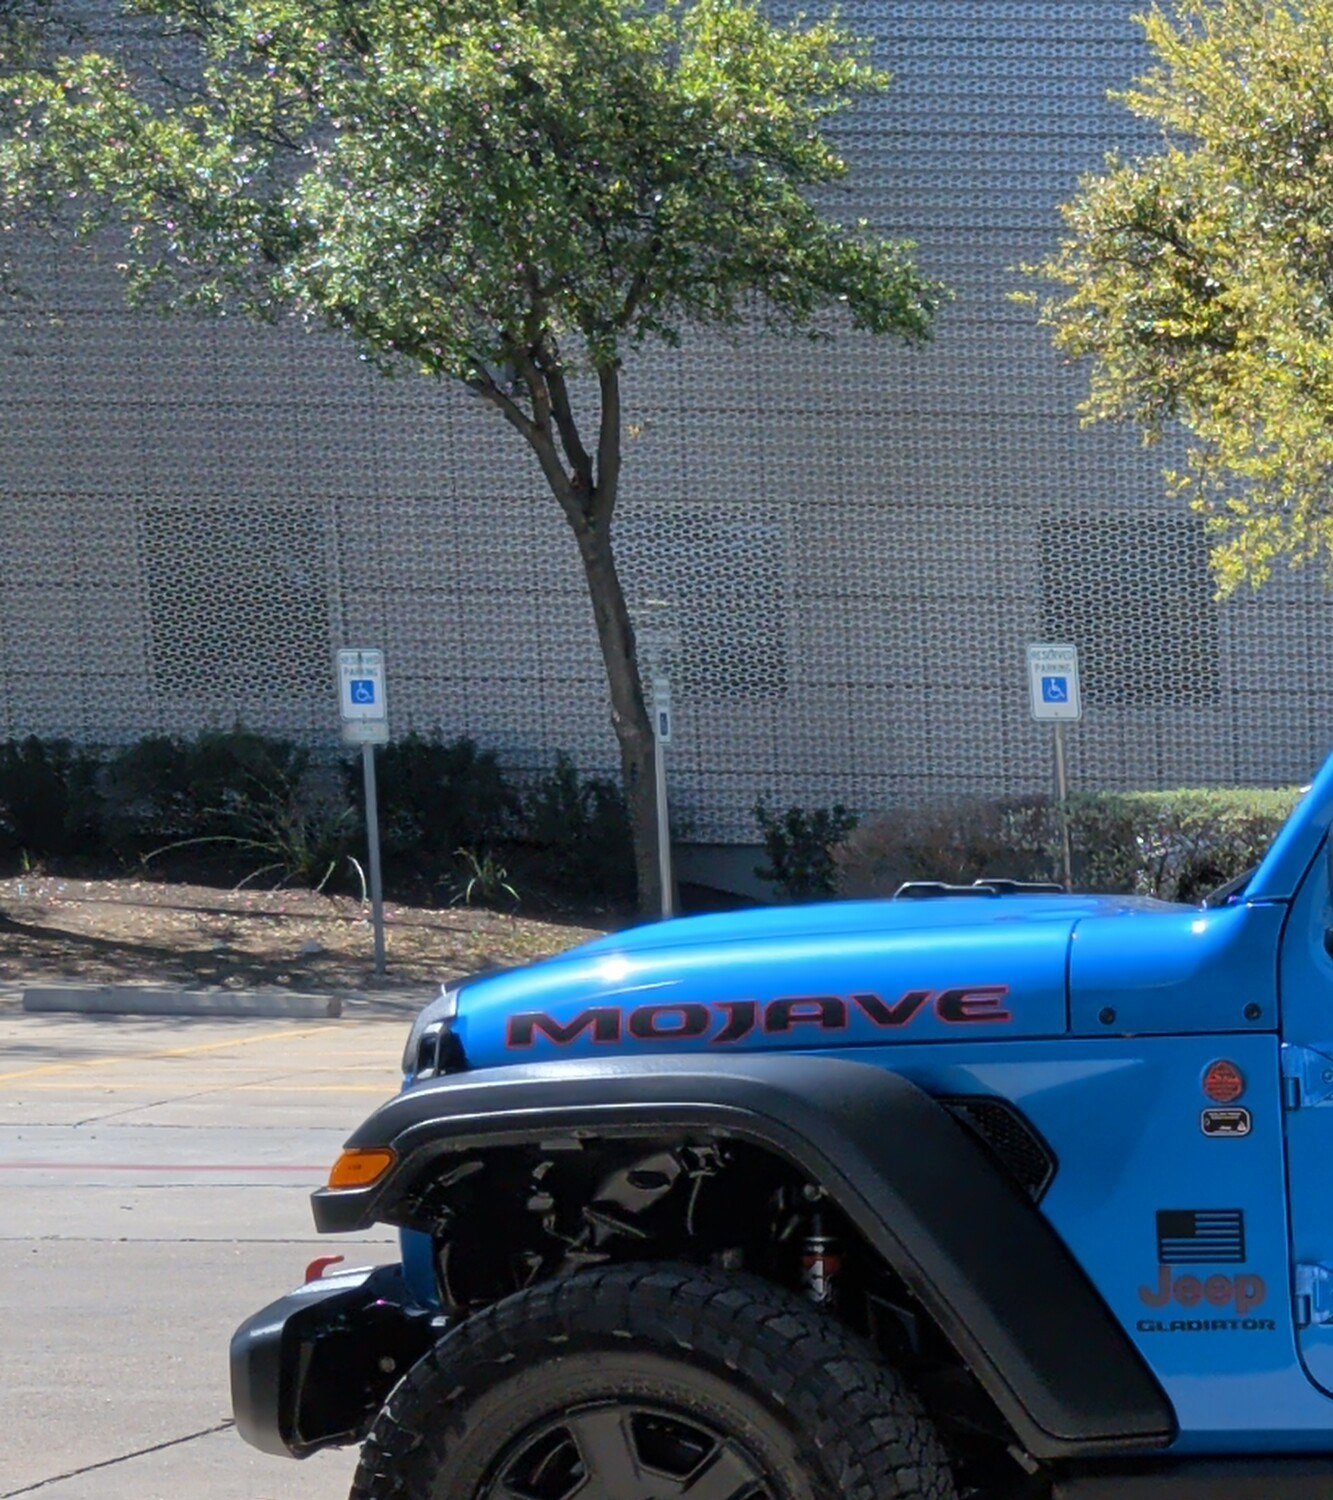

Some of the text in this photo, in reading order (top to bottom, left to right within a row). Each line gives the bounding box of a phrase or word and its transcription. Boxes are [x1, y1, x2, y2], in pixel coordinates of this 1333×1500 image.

[506, 985, 1012, 1049] MOJAVE
[1138, 1264, 1268, 1317] Jeep
[1136, 1319, 1277, 1333] GLADIATOR
